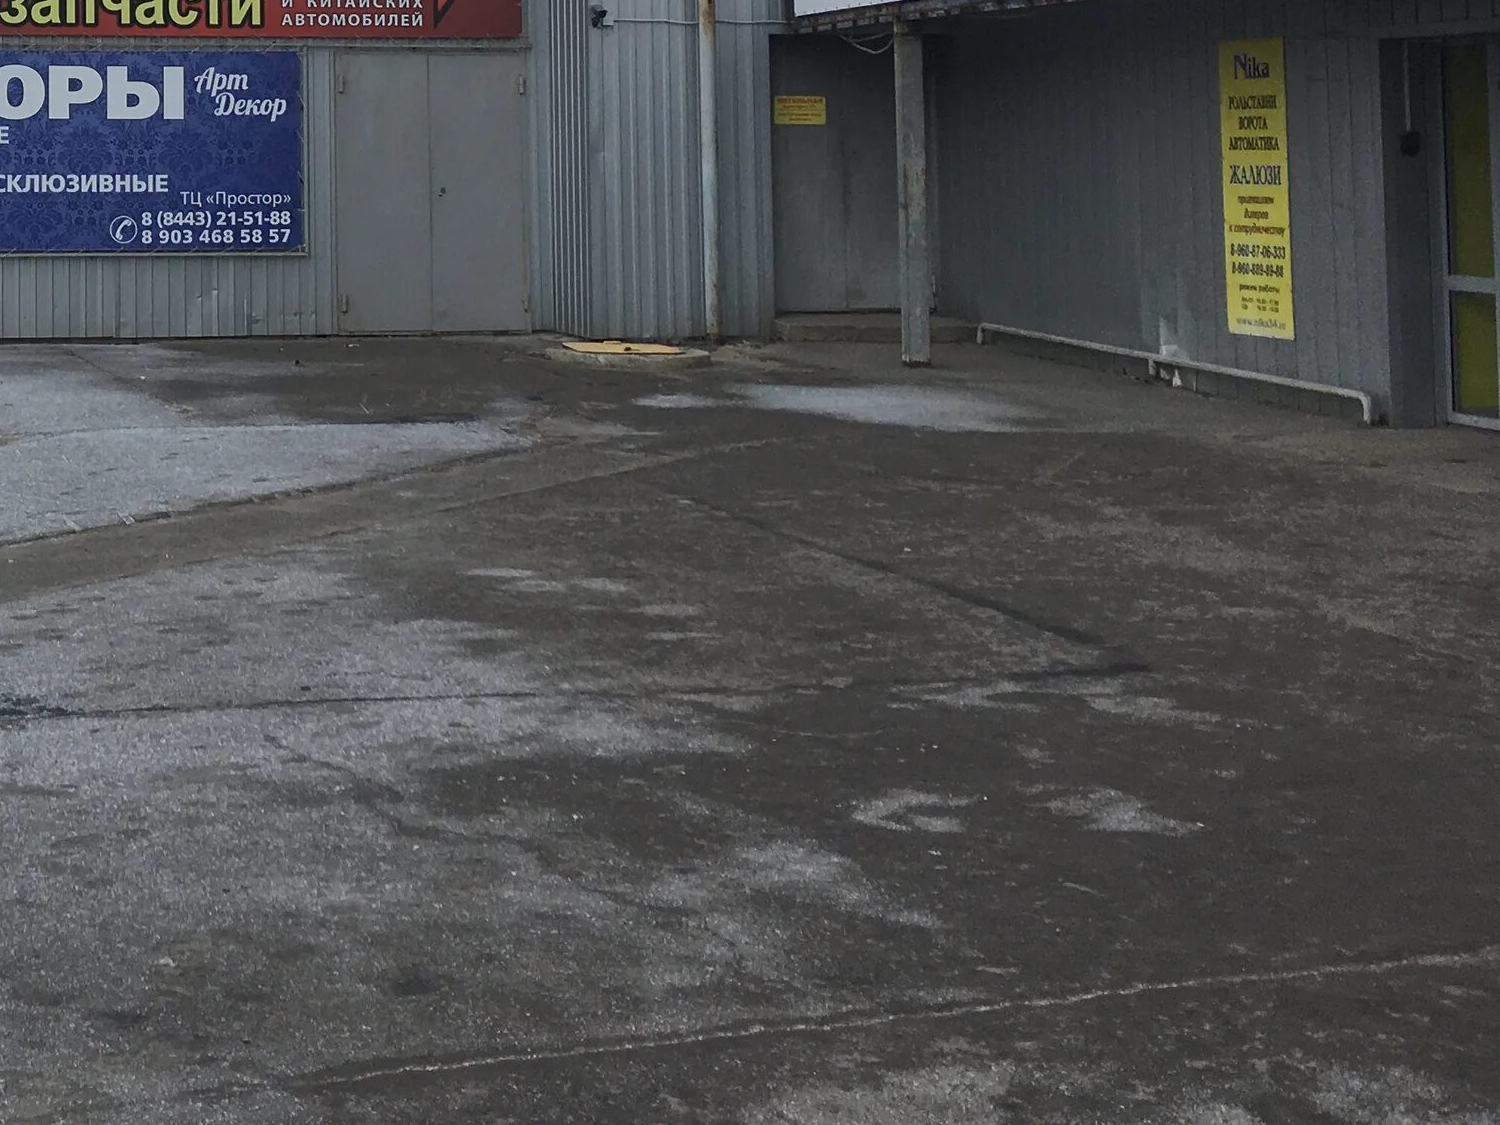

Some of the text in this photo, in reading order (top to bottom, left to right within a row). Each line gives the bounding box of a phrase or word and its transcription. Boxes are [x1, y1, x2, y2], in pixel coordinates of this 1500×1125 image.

[282, 11, 424, 27] АВТОМОБИЛЕЙ
[1234, 54, 1270, 79] Nika
[194, 66, 249, 97] Арт
[214, 92, 287, 122] Декор
[1228, 95, 1277, 110] РОЛЬСТАВНИ
[1239, 116, 1268, 130] ВОРОТА
[1228, 137, 1280, 151] АВТОМАТИКА
[1229, 165, 1282, 185] ЖАЛЮЗИ
[180, 192, 292, 208] ТЦ «Простор»
[141, 210, 291, 228] 8 (8443) 21-51-88
[141, 229, 291, 244] 8 903 468 58 57
